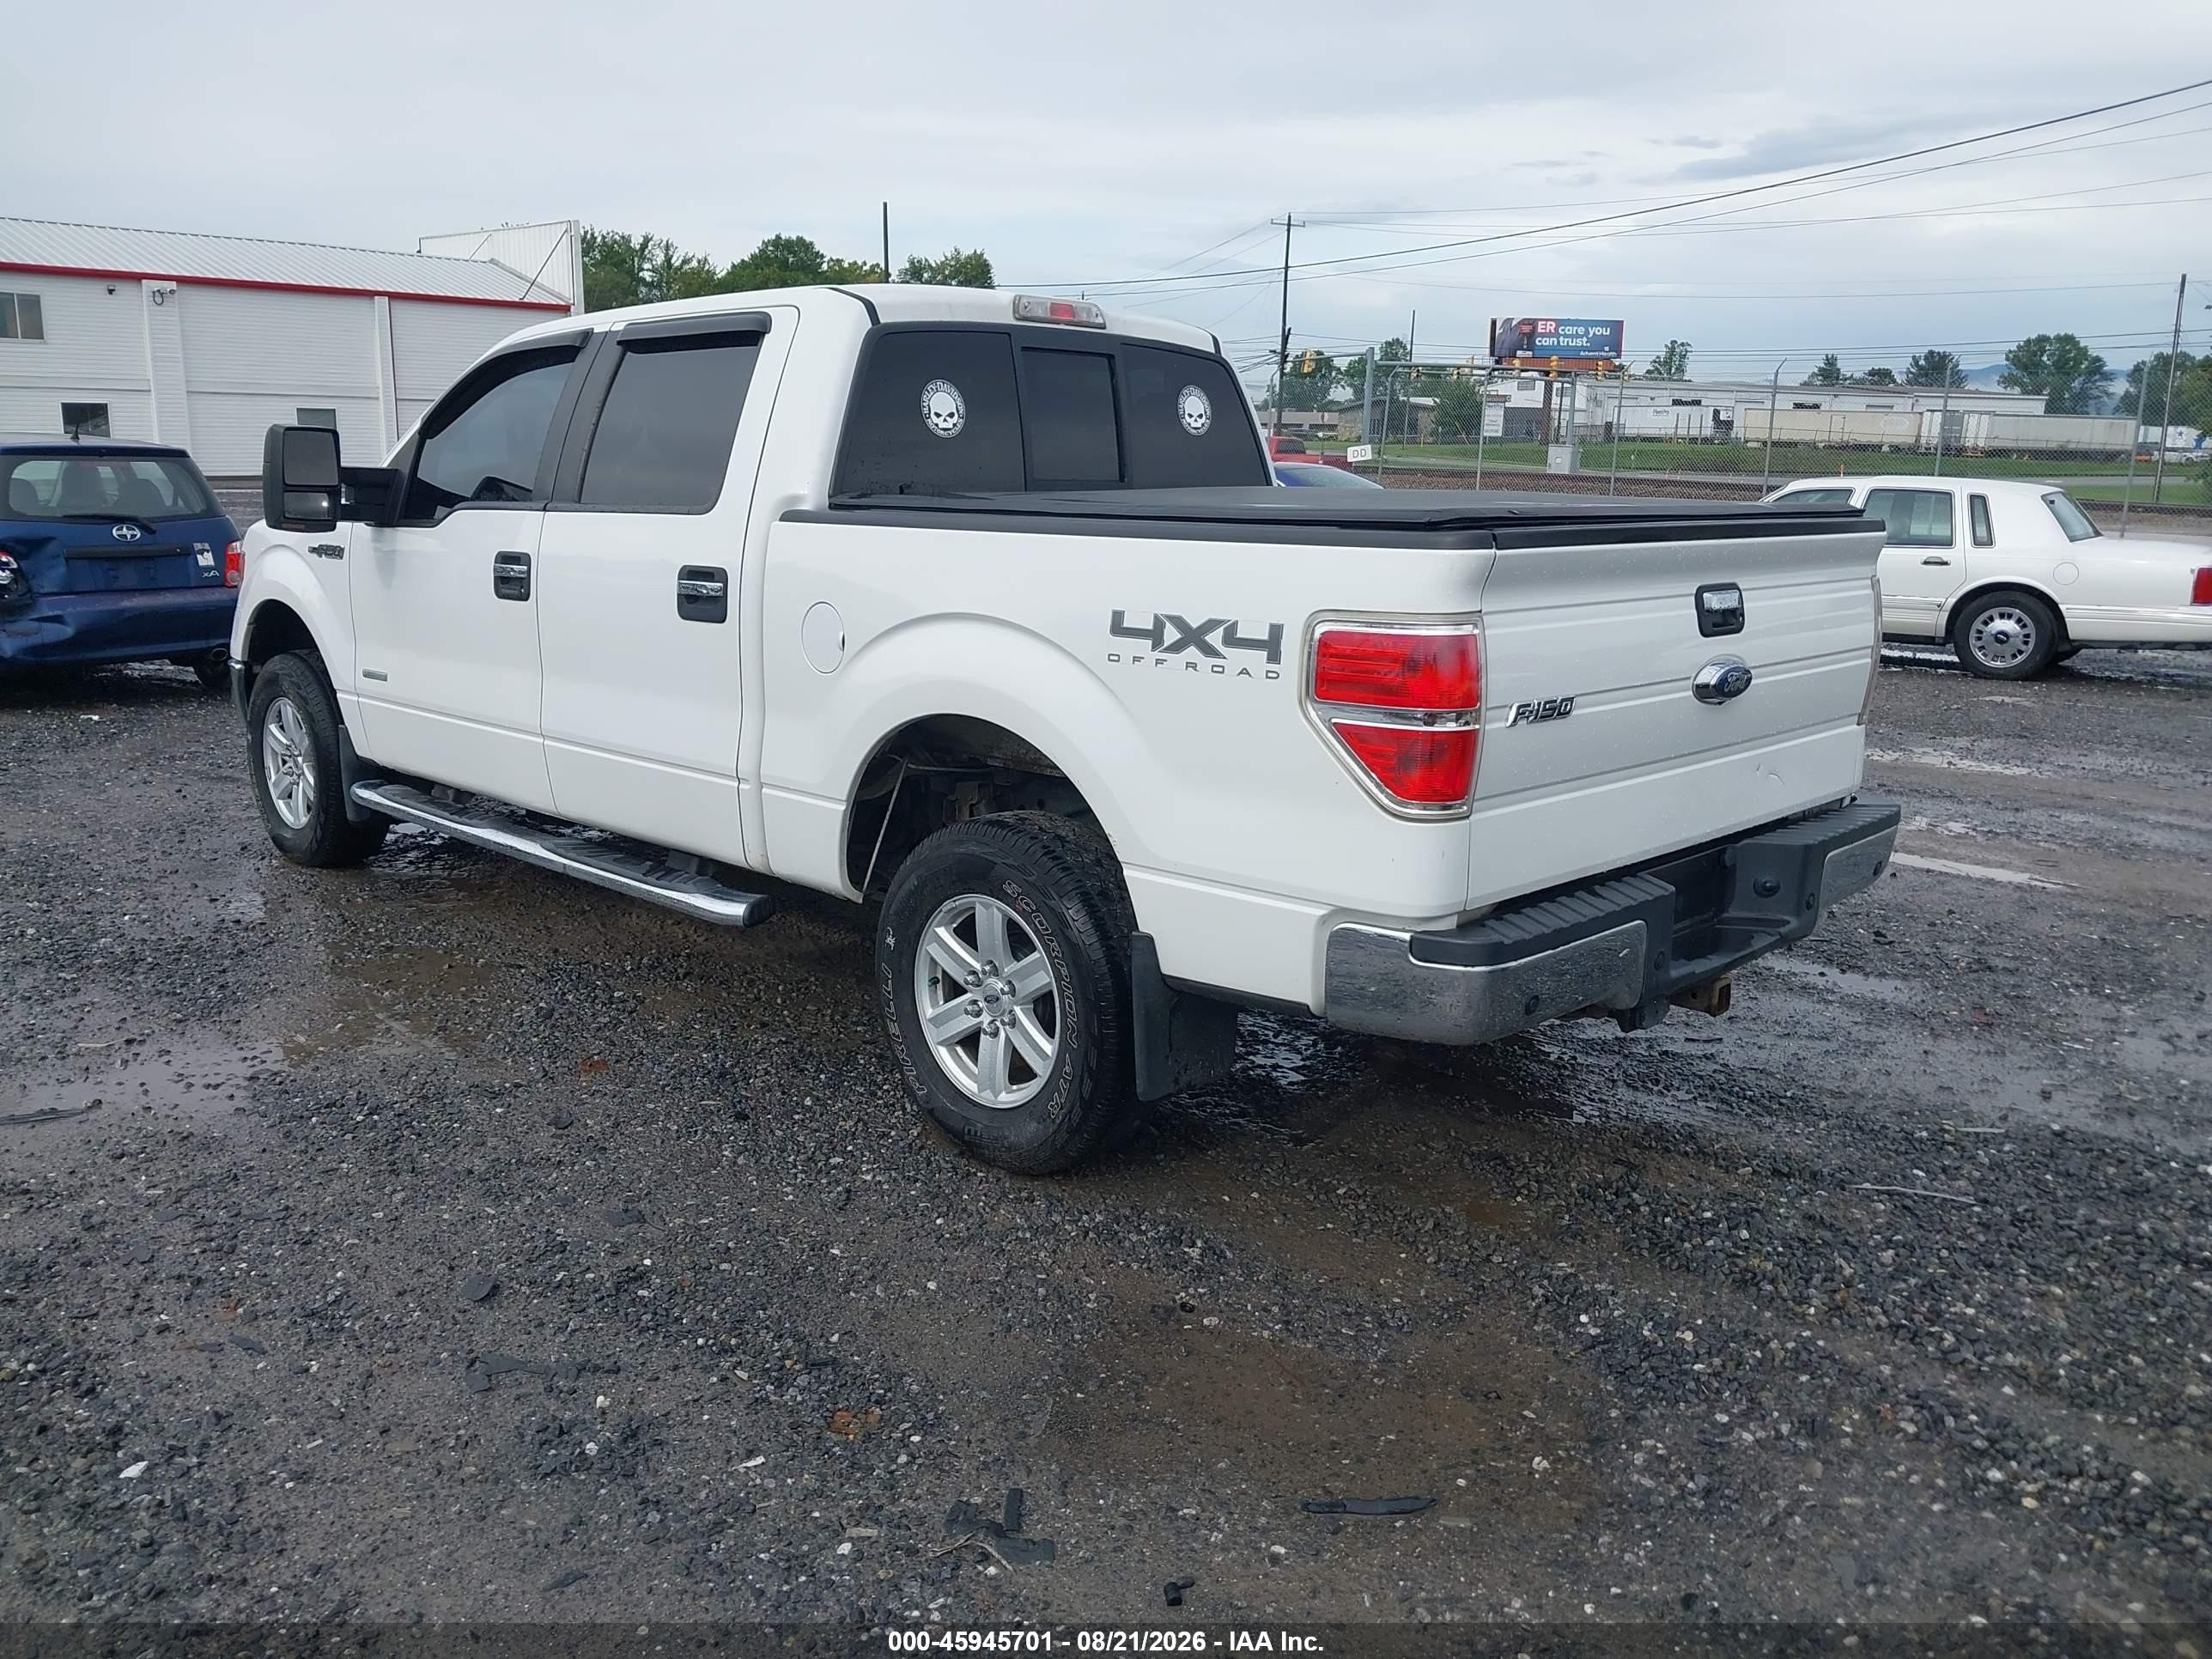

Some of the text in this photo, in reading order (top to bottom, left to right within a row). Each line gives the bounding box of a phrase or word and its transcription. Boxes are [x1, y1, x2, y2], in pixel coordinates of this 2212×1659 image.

[1538, 321, 1610, 337] ER care you
[1535, 336, 1590, 347] can trust.
[927, 417, 963, 436] MOTORCYCLES
[1352, 448, 1367, 459] DD
[1723, 671, 1752, 692] Ford
[1002, 879, 1079, 1121] SCORPION ATR
[879, 962, 928, 1096] PIRELLI
